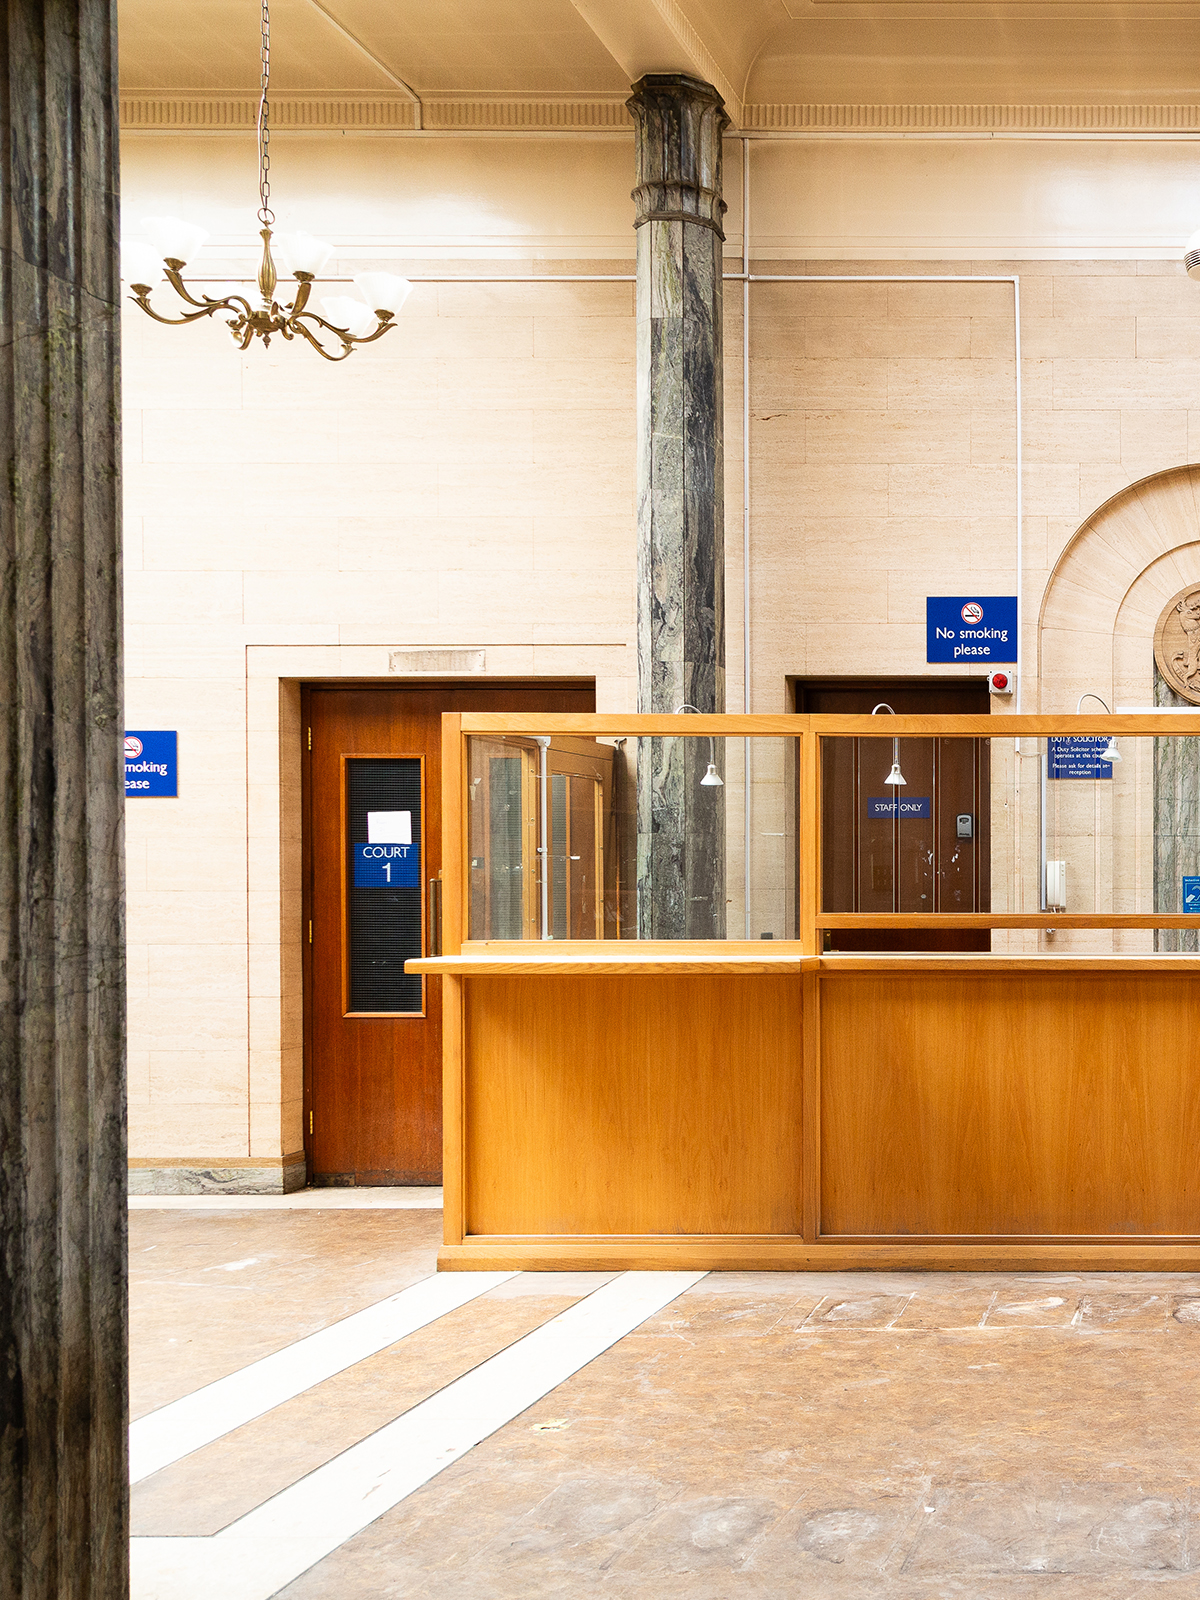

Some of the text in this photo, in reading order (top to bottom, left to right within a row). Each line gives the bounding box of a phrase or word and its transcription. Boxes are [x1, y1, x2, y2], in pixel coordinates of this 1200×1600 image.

[936, 627, 1008, 642] No smoking
[954, 643, 991, 659] please
[124, 761, 168, 776] moking
[124, 780, 150, 789] ease
[874, 803, 922, 812] STAFF ONLY
[363, 846, 410, 858] COURT
[382, 862, 391, 883] 1
